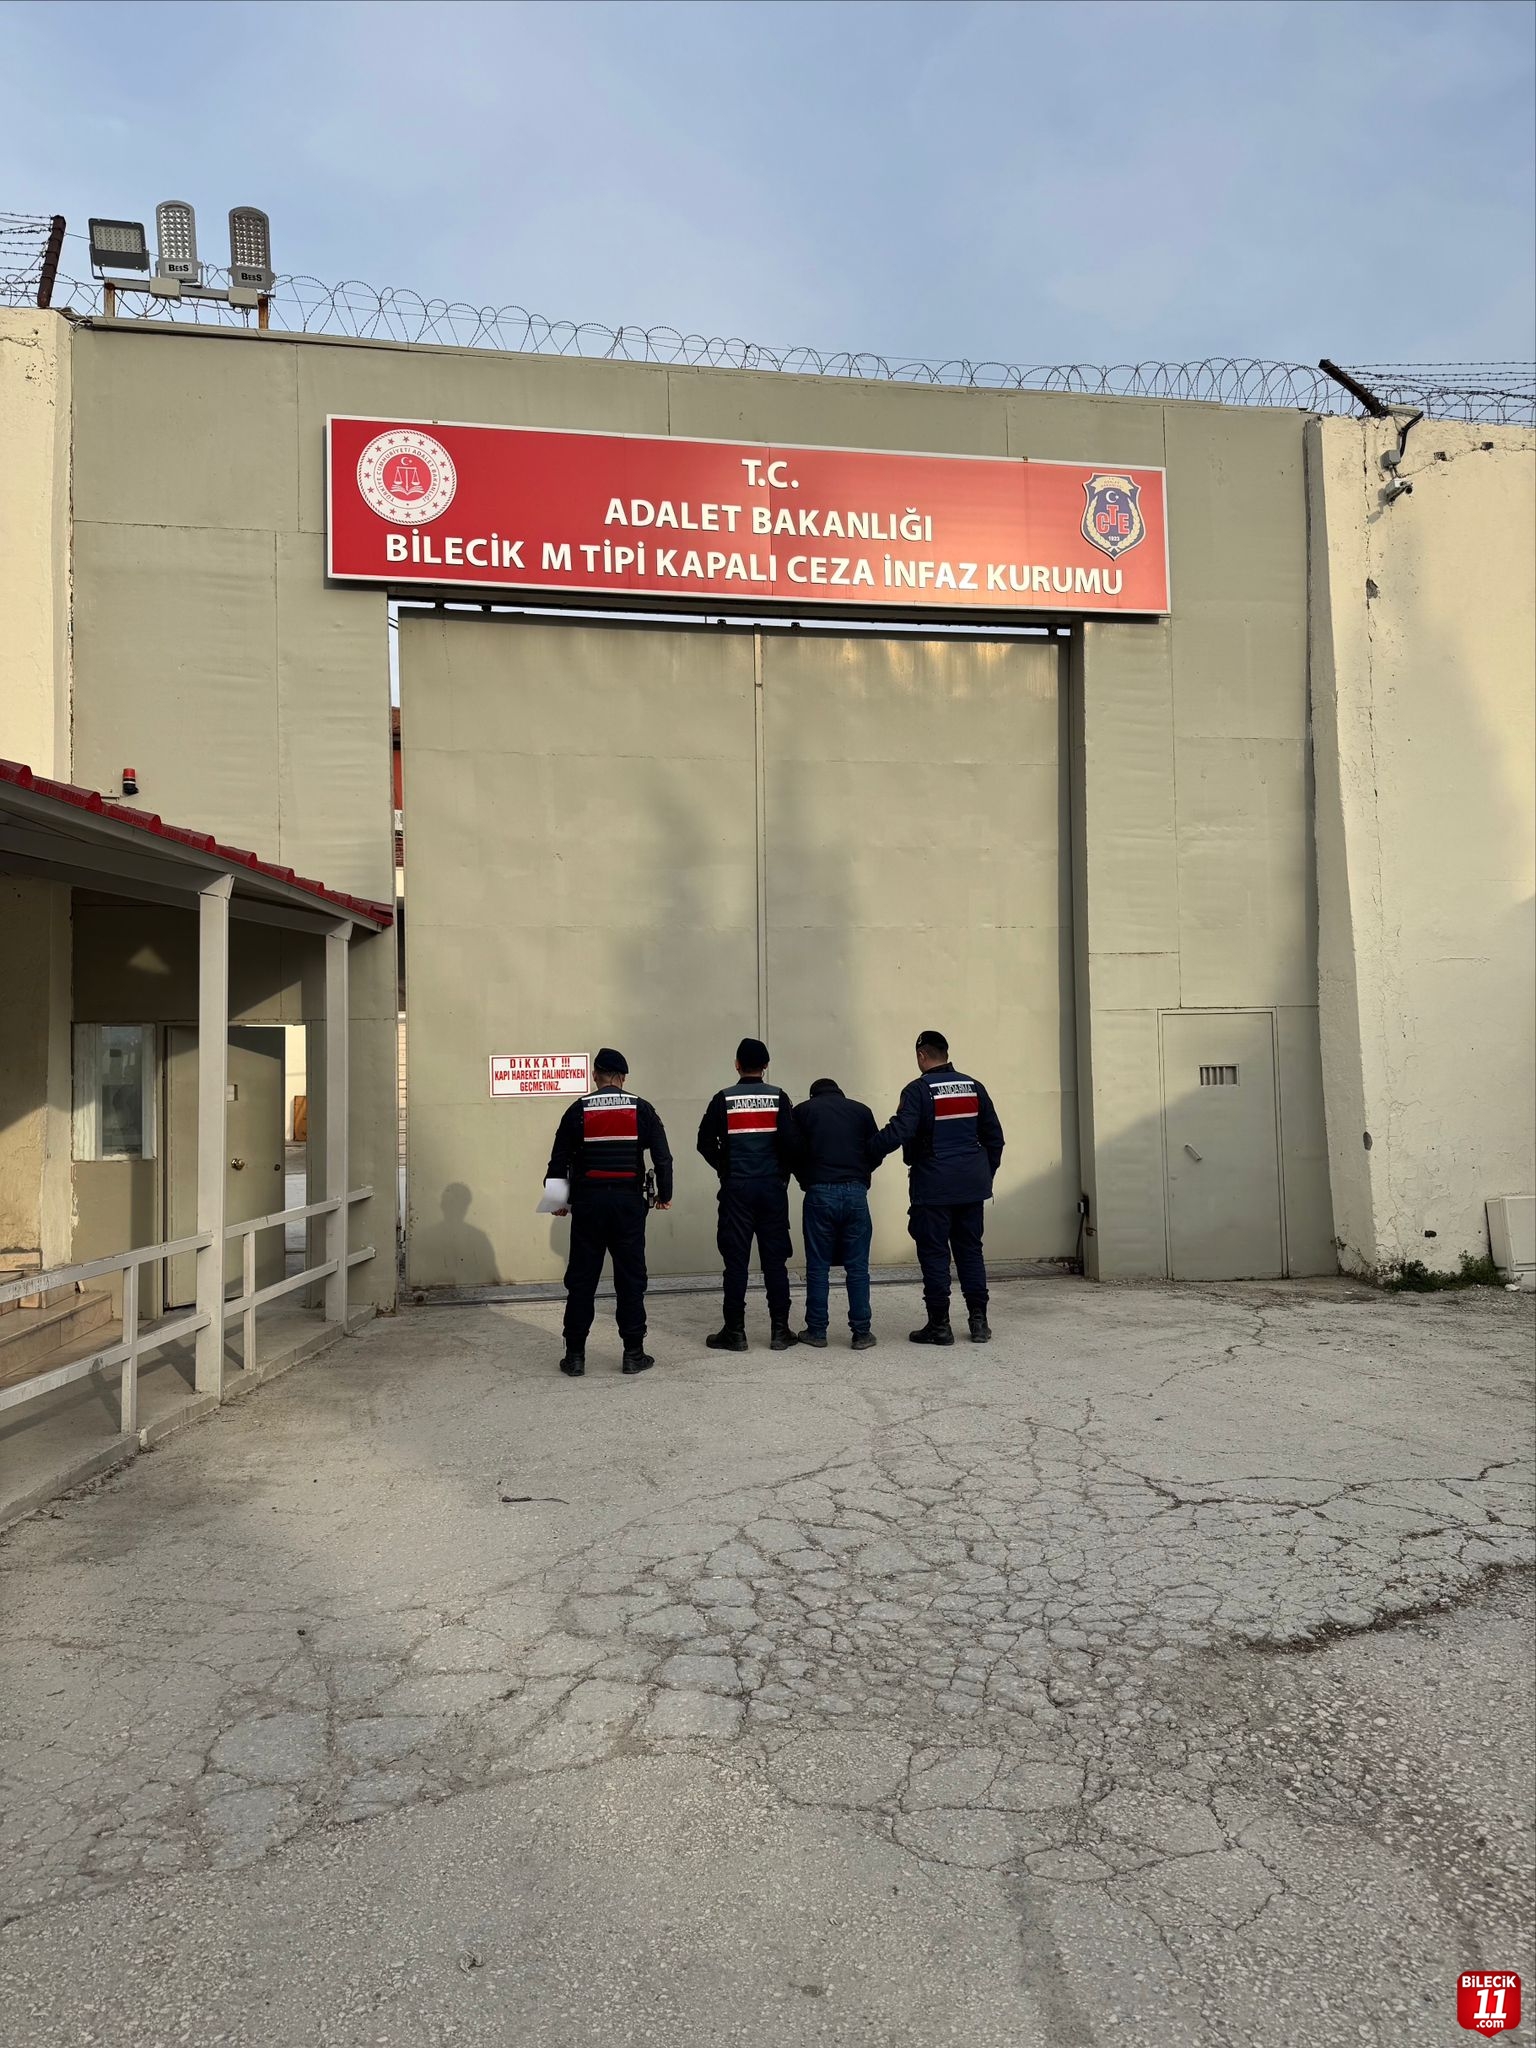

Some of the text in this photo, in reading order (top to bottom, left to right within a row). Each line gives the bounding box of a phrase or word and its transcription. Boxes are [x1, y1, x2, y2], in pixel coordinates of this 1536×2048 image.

[412, 449, 434, 467] ADALET
[741, 458, 799, 489] T.C.
[604, 498, 933, 542] ADALET BAKANLIĞI
[386, 528, 1123, 595] BİLECİK M TİPİ KAPALI CEZA İNFAZ KURUMU
[494, 1070, 510, 1080] KAPI
[511, 1070, 540, 1080] HAREKET
[936, 1084, 973, 1095] JANDARMA
[587, 1096, 631, 1106] JANDARMA
[732, 1098, 775, 1110] JANDARMA
